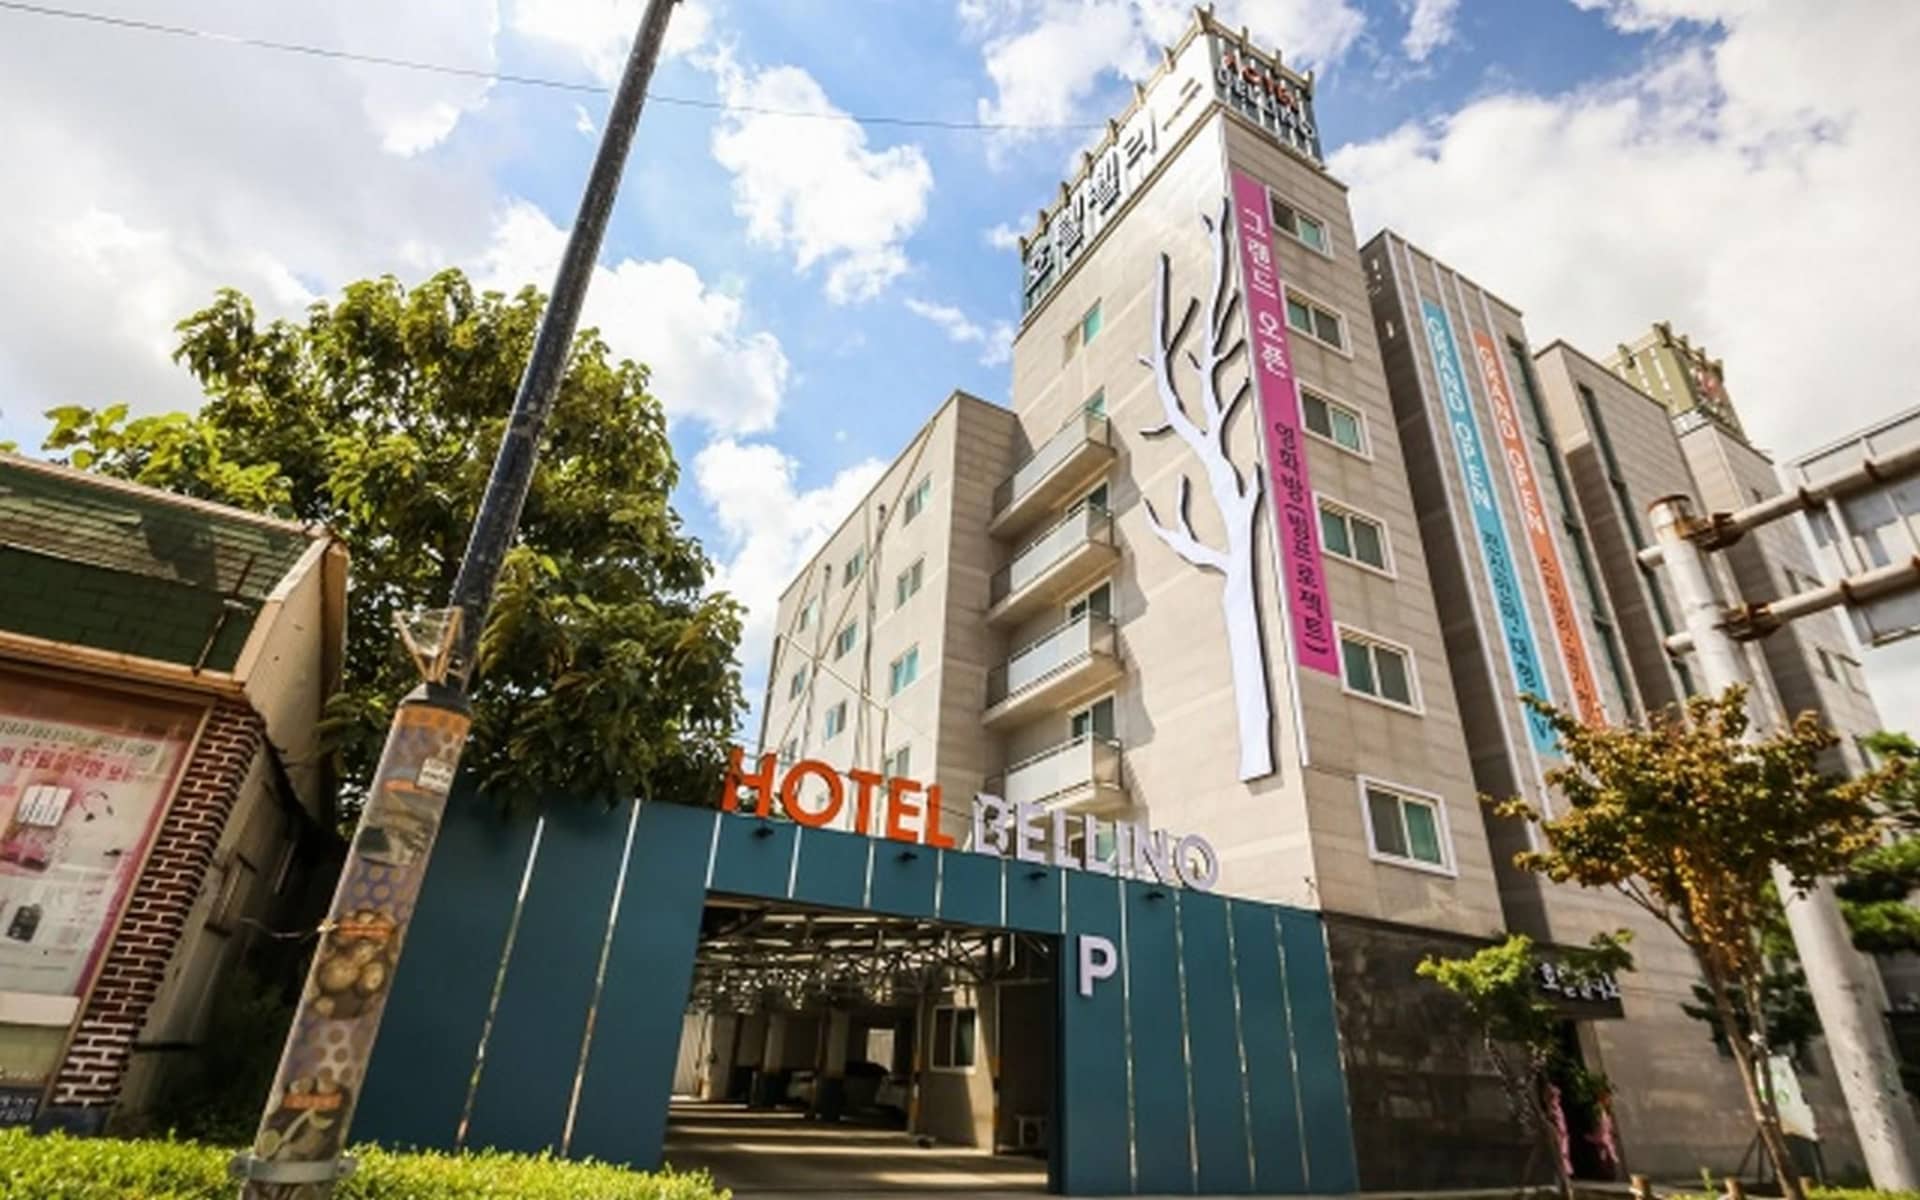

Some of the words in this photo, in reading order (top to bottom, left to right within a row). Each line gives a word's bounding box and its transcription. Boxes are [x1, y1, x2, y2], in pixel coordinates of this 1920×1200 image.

[1258, 311, 1288, 380] 오픈
[1427, 316, 1465, 413] GRAND
[1455, 421, 1494, 513] OPEN
[1478, 346, 1518, 440] GRAND
[1509, 449, 1548, 536] OPEN
[721, 746, 955, 849] HOTEL
[972, 792, 1220, 893] BELLINO
[1077, 934, 1118, 997] P
